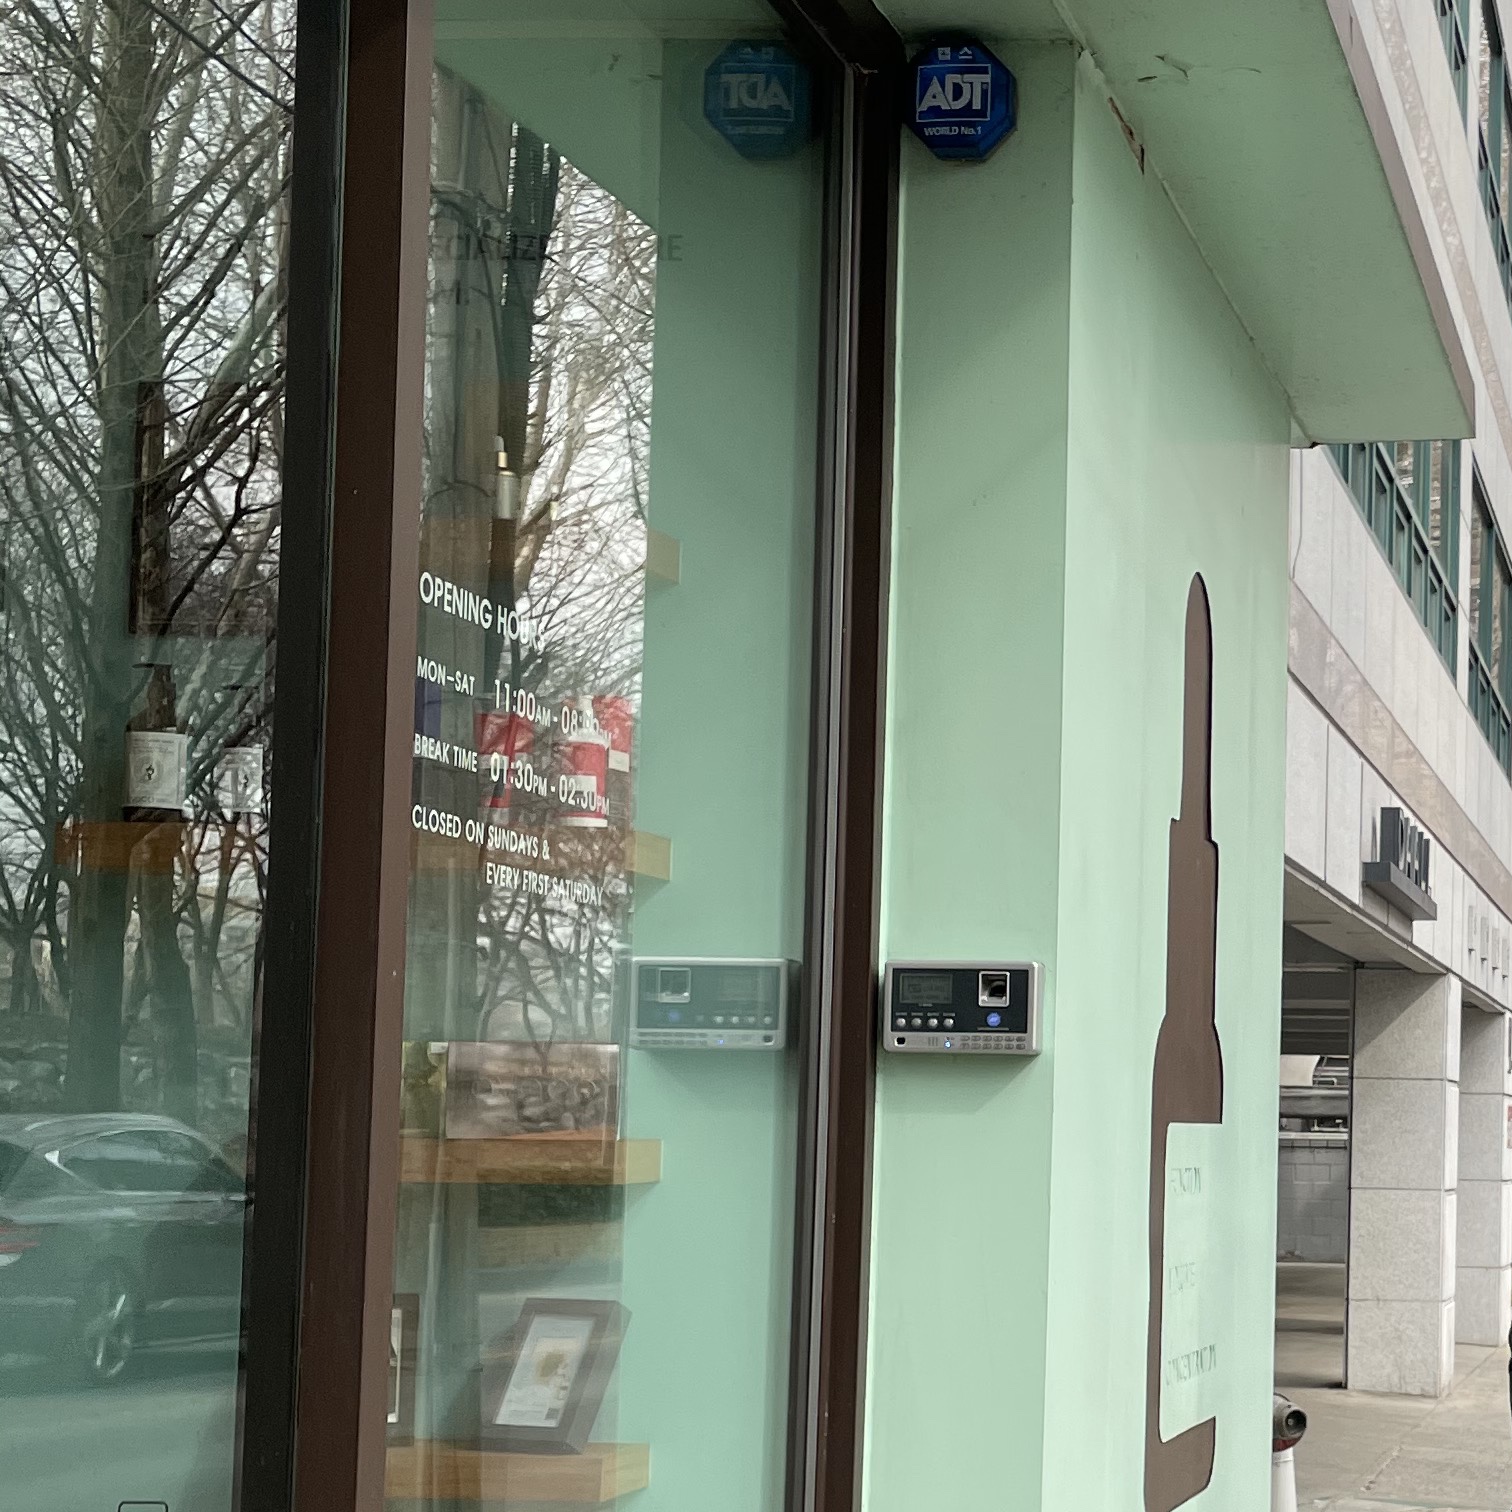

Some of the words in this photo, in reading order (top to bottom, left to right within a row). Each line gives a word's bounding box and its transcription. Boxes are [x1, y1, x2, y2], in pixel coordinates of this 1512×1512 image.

[918, 73, 990, 111] ADT
[923, 126, 960, 136] WORLD
[419, 571, 493, 630] OPENING
[497, 604, 545, 650] HOURS
[417, 655, 476, 697] MON-SAT
[494, 679, 551, 728] 11:00AM
[414, 733, 450, 764] BREAK
[453, 745, 478, 773] TIME
[490, 752, 548, 797] 01:30PM
[559, 775, 609, 816] 02:30PM
[412, 804, 462, 839] CLOSED
[465, 819, 485, 845] ON
[488, 824, 539, 859] SUNDAYS
[542, 839, 551, 861] &
[486, 862, 520, 890] EVERY
[523, 869, 549, 896] FIRST
[551, 876, 604, 907] SATURDAY
